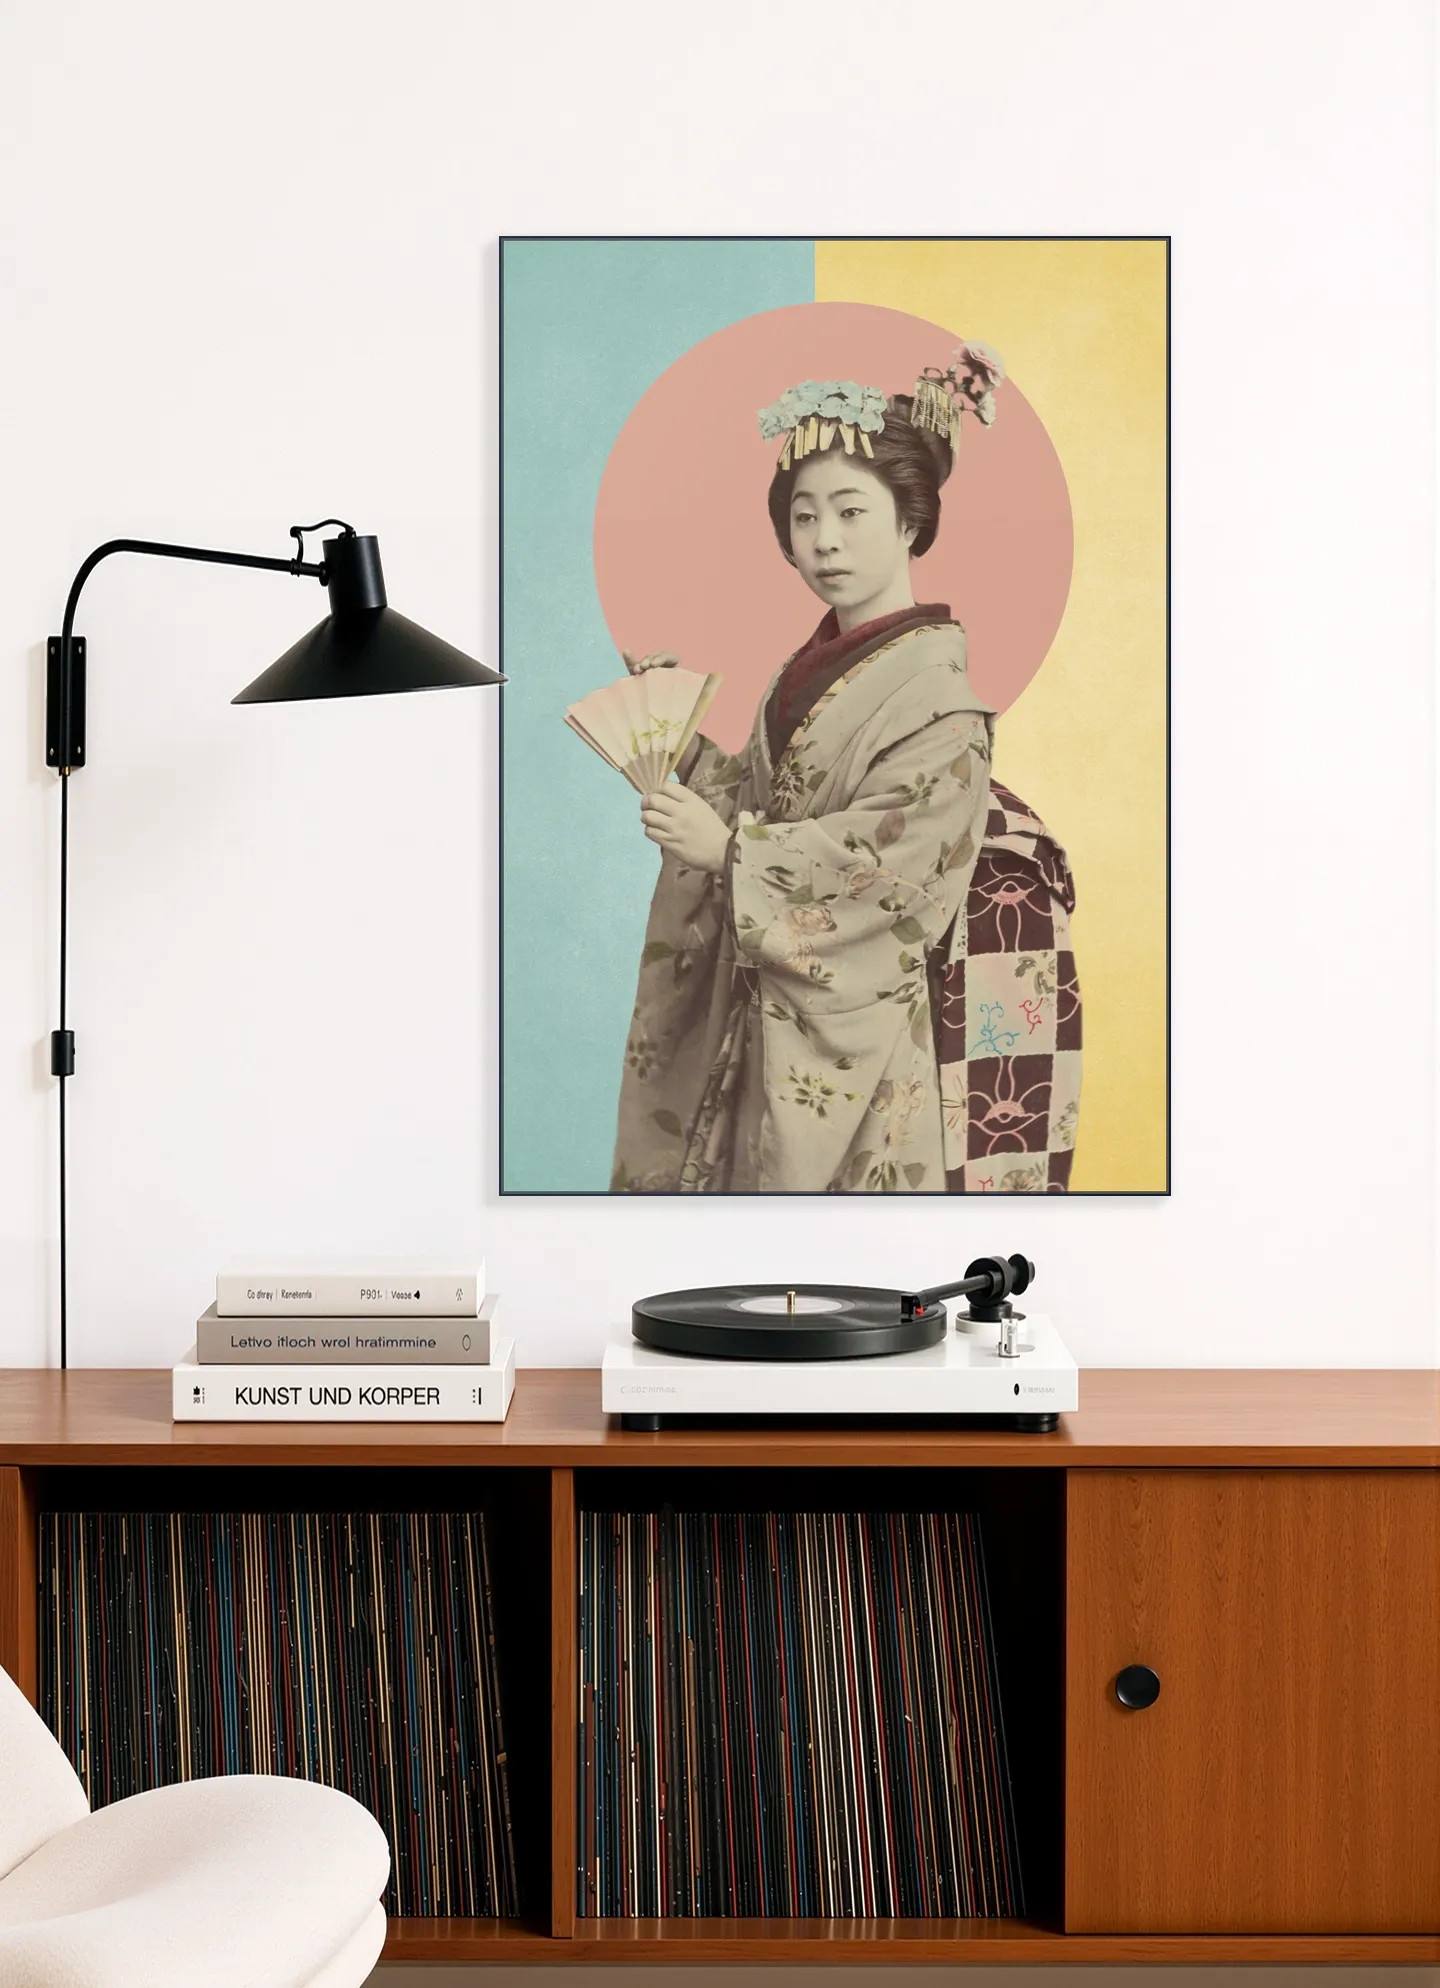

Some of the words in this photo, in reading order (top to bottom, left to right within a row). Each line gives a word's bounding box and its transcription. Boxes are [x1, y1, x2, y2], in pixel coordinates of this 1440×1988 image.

[235, 1387, 302, 1406] KUNST
[309, 1387, 351, 1406] UND
[359, 1387, 440, 1406] KORPER
